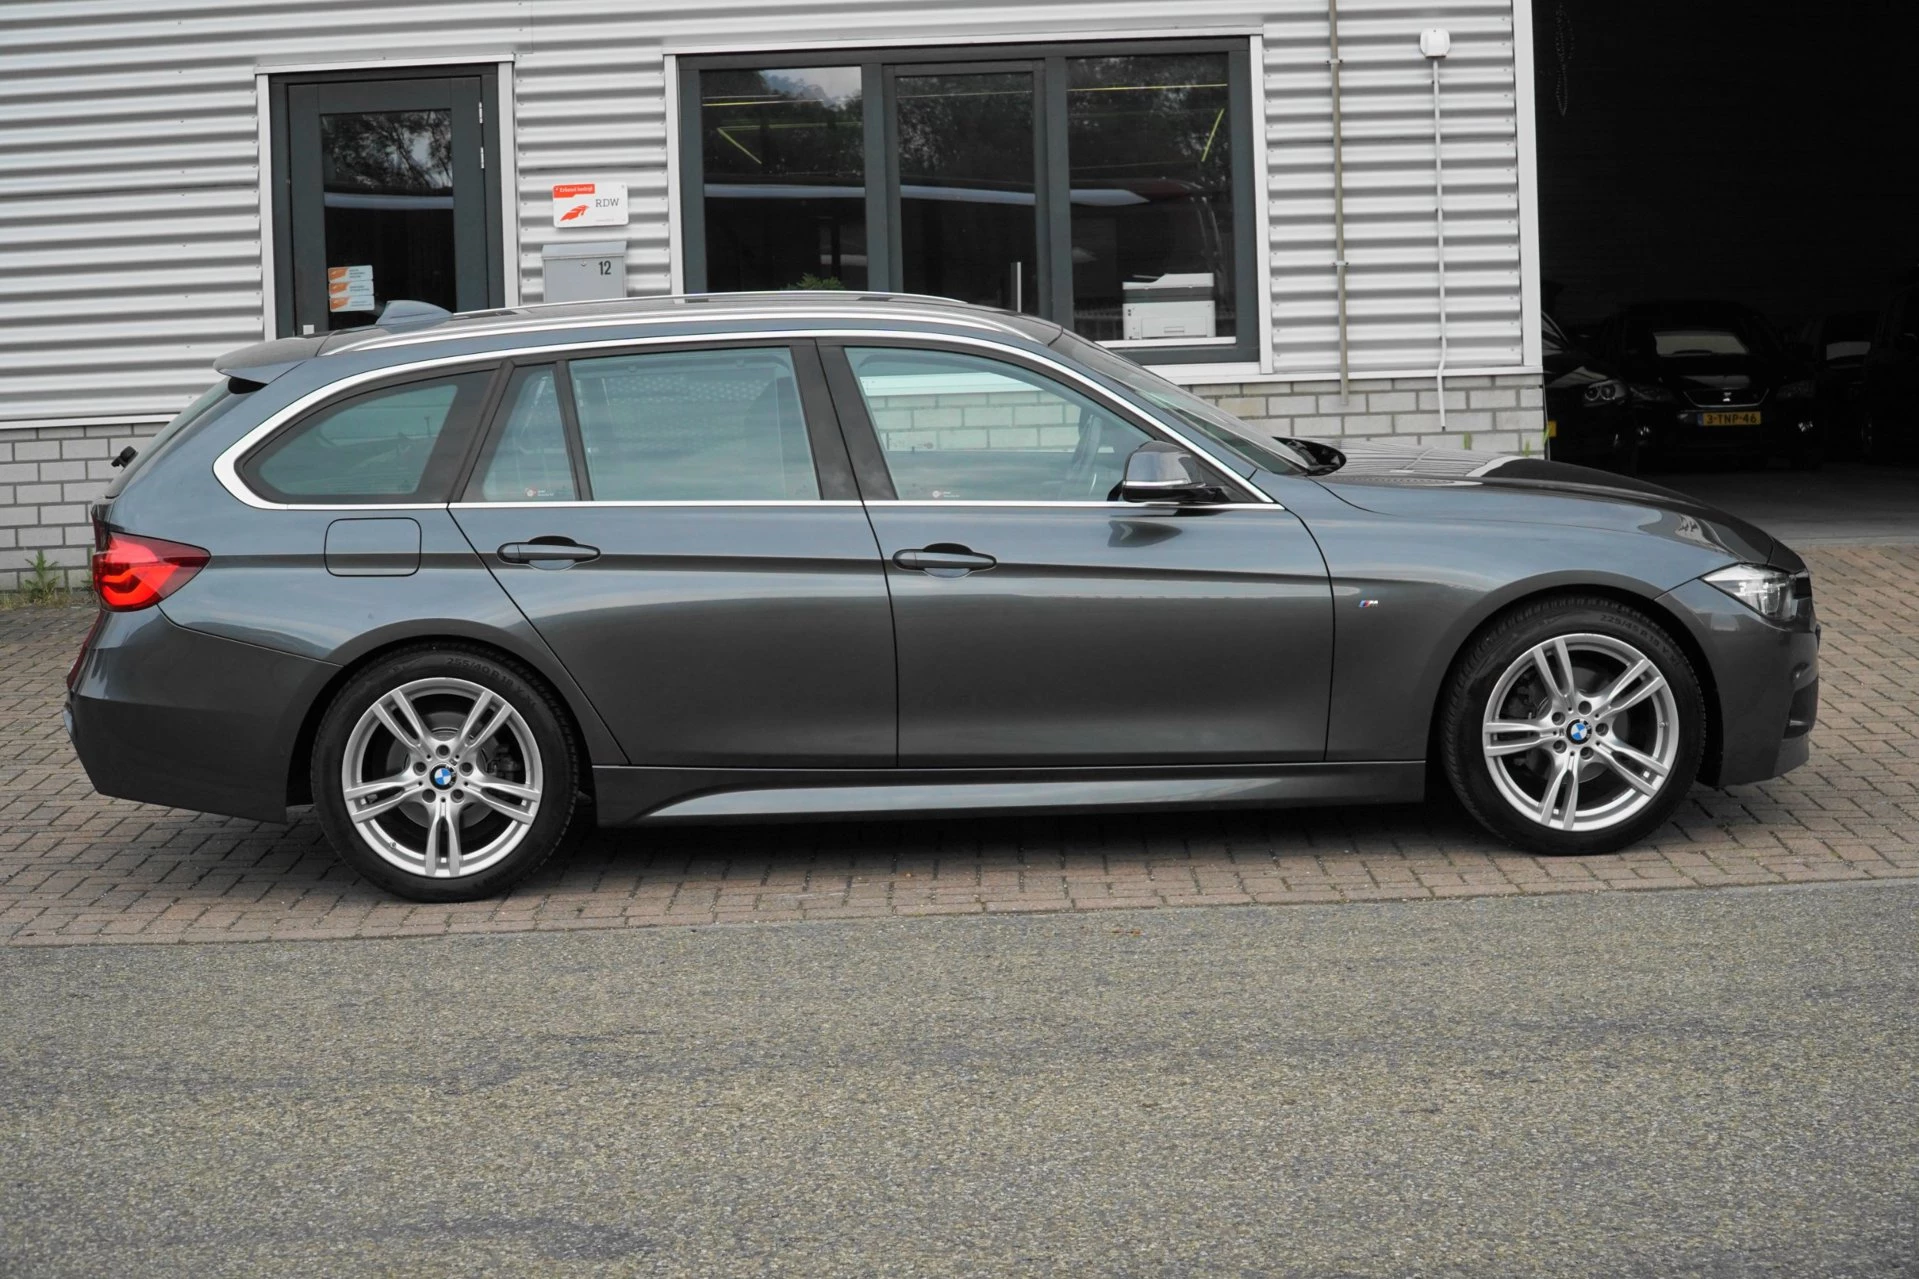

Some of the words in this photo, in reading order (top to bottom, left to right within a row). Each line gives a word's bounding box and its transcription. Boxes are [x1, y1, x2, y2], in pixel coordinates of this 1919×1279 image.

[595, 198, 620, 208] RDW
[598, 260, 612, 275] 12
[1706, 413, 1757, 425] 3-TNP-46
[447, 657, 491, 675] 255/40
